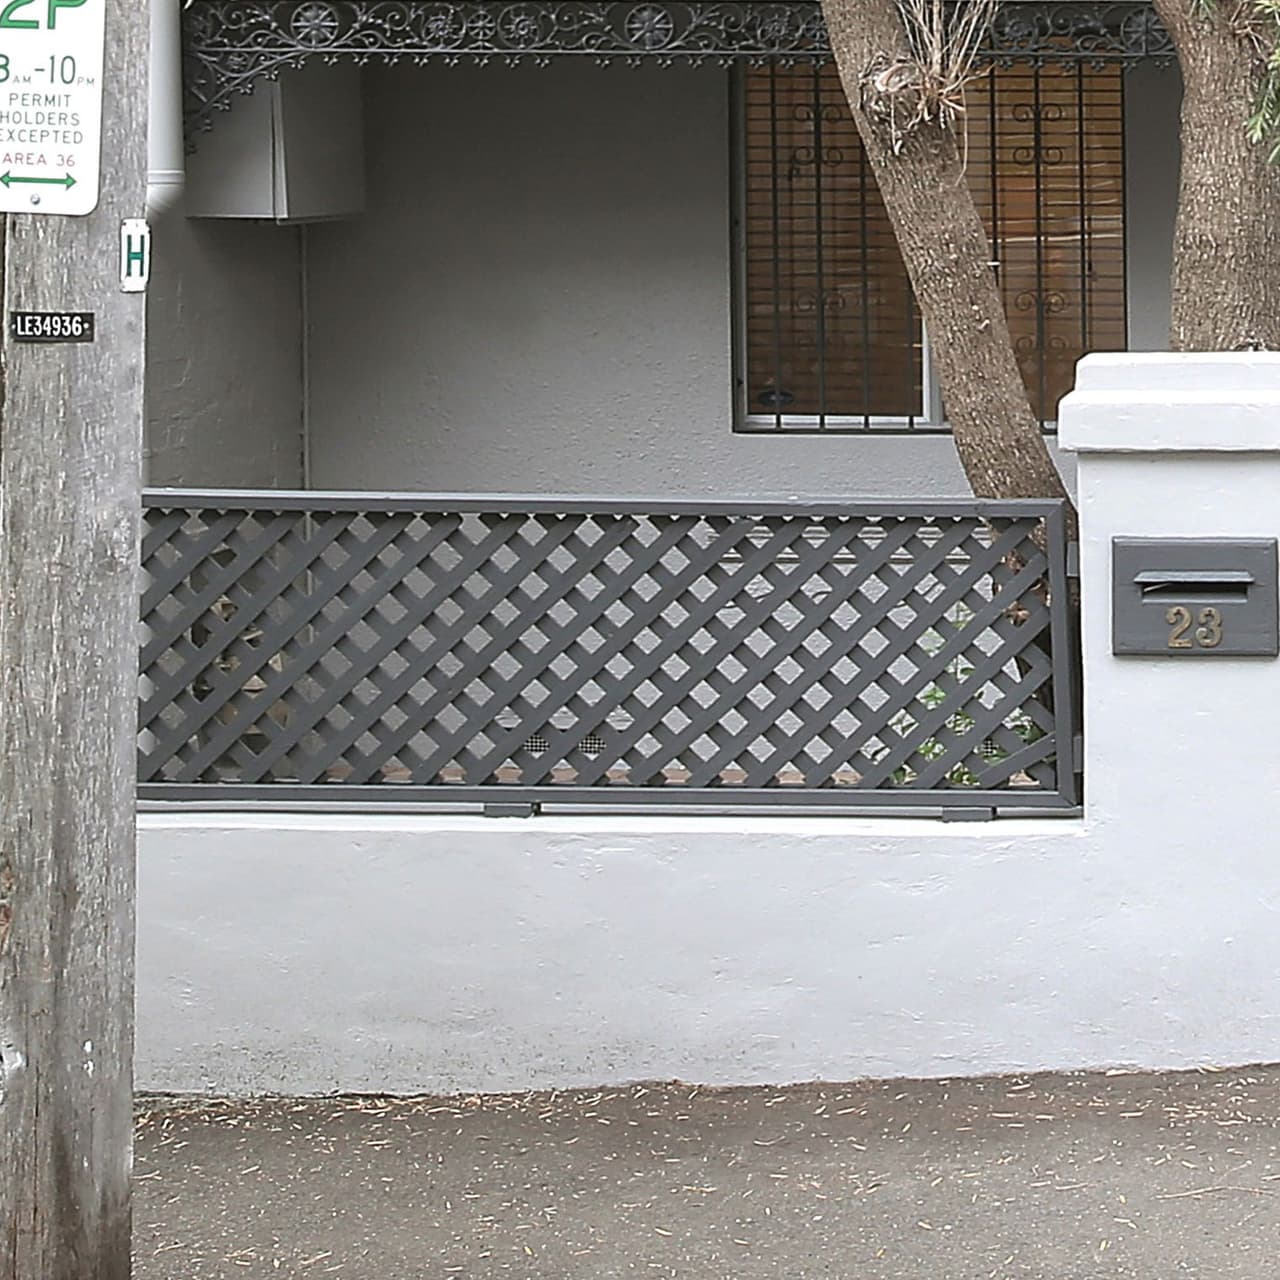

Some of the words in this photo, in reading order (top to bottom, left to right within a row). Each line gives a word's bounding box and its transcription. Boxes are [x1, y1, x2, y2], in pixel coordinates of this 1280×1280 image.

[8, 92, 72, 108] PERMIT
[0, 110, 80, 126] HOLDERS
[2, 152, 47, 165] AREA
[56, 154, 75, 167] 36
[127, 234, 145, 277] H
[16, 315, 83, 336] LE34936
[1166, 606, 1223, 648] 23
